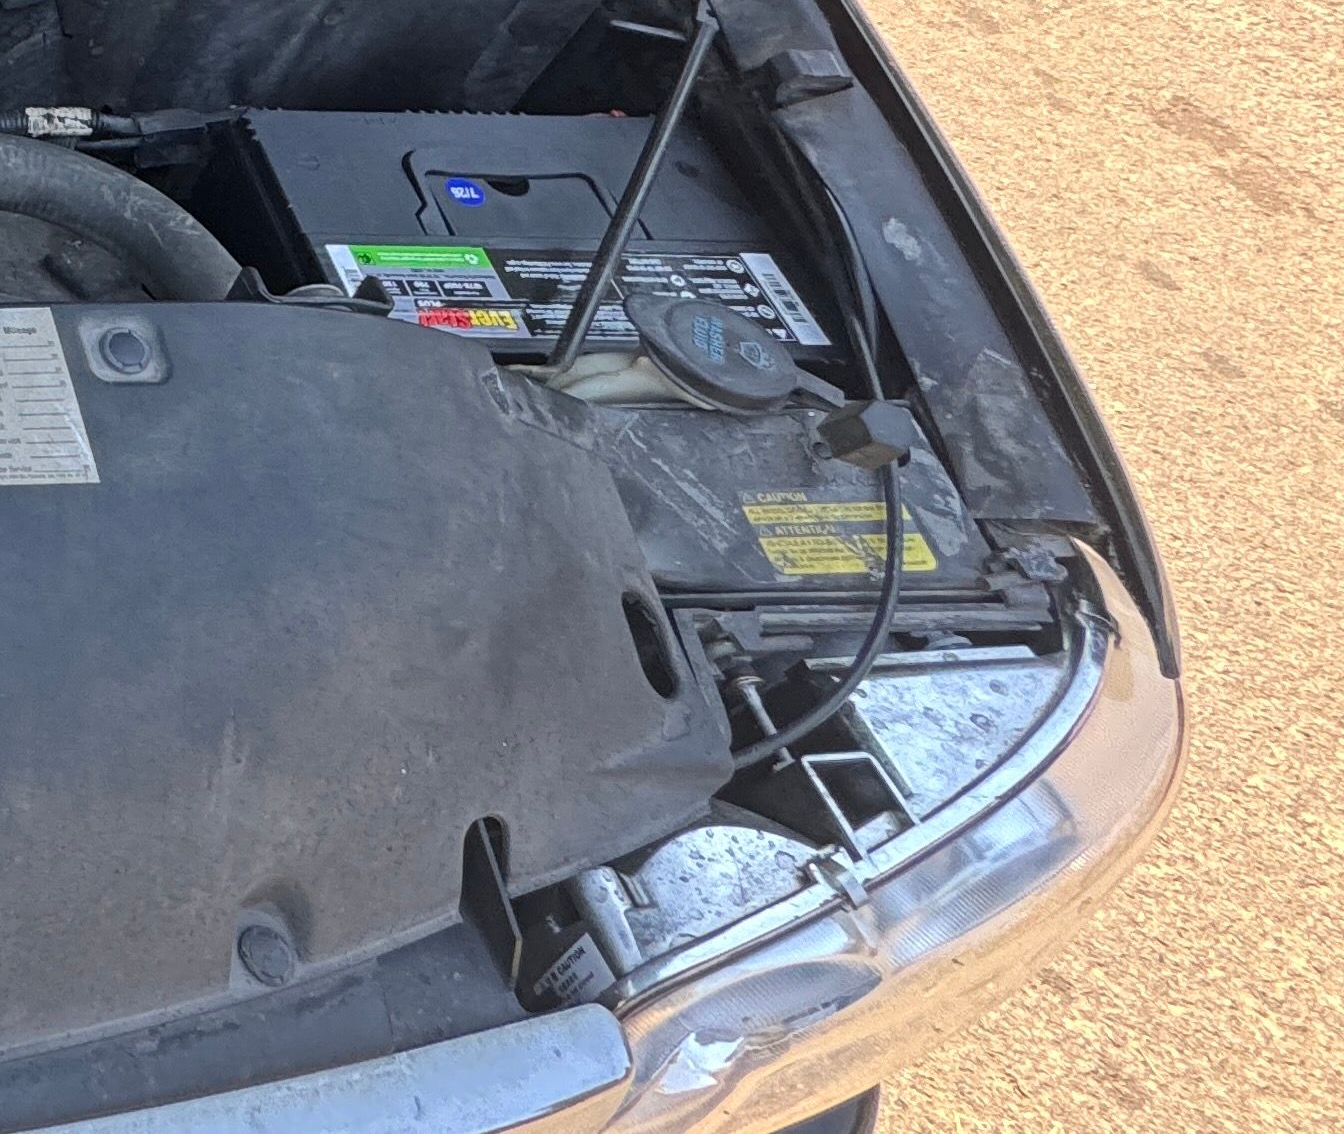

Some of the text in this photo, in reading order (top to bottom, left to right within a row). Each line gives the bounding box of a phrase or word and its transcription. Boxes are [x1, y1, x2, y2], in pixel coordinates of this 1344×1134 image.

[693, 316, 708, 352] FLUID
[708, 316, 724, 364] WASHER
[757, 492, 807, 502] CAUTION
[774, 524, 836, 535] ATTENTION
[557, 946, 586, 976] CAUTION
